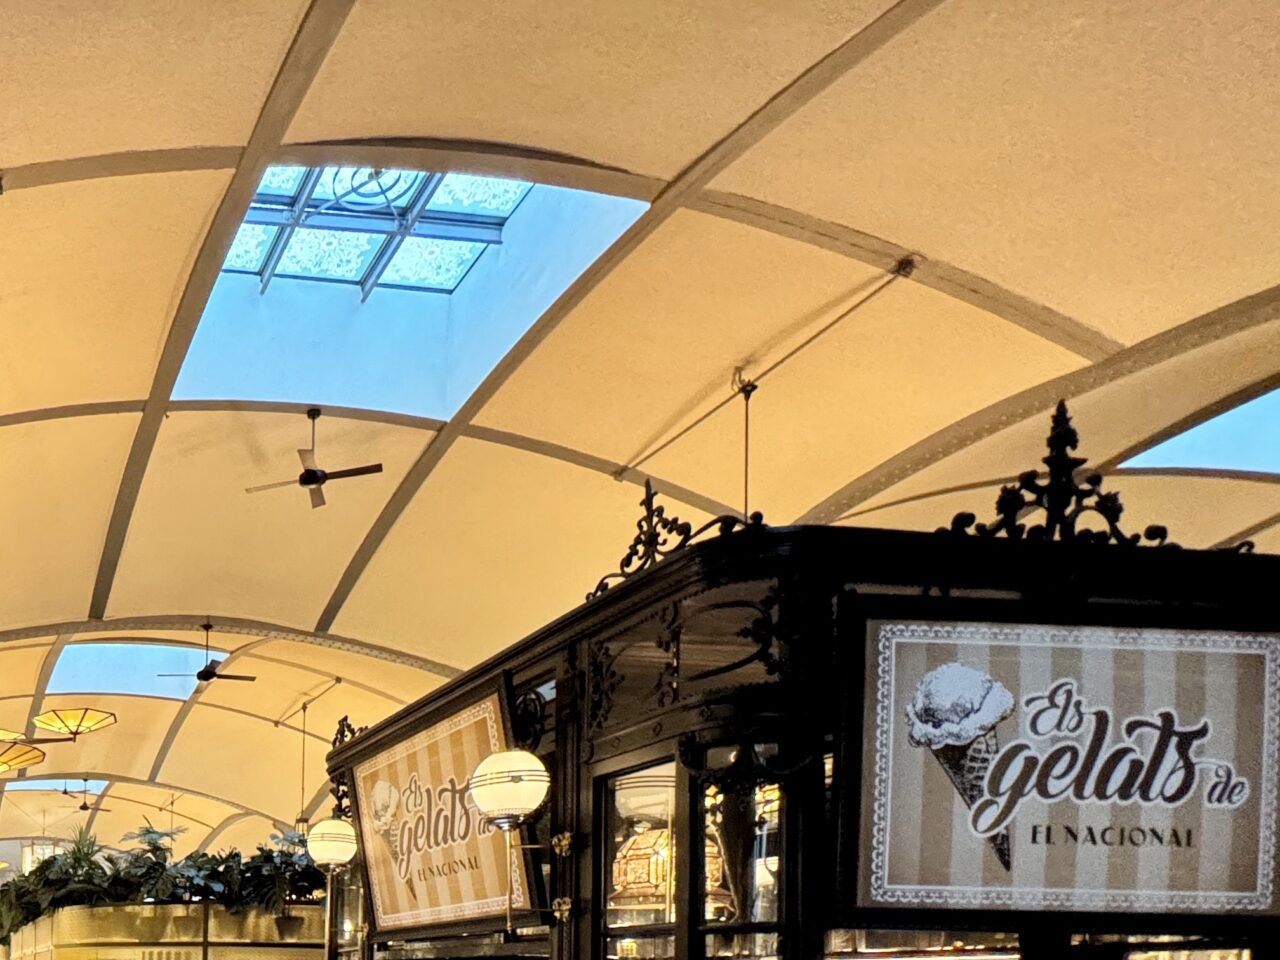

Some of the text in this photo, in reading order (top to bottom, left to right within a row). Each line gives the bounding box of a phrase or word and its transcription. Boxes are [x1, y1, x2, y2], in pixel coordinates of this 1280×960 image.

[1024, 681, 1084, 737] Els
[402, 774, 423, 814] Els
[971, 709, 1247, 834] gelats de
[398, 777, 471, 880] gelats
[1031, 824, 1196, 848] EL NACIONAL
[428, 855, 481, 878] NACIONAL
